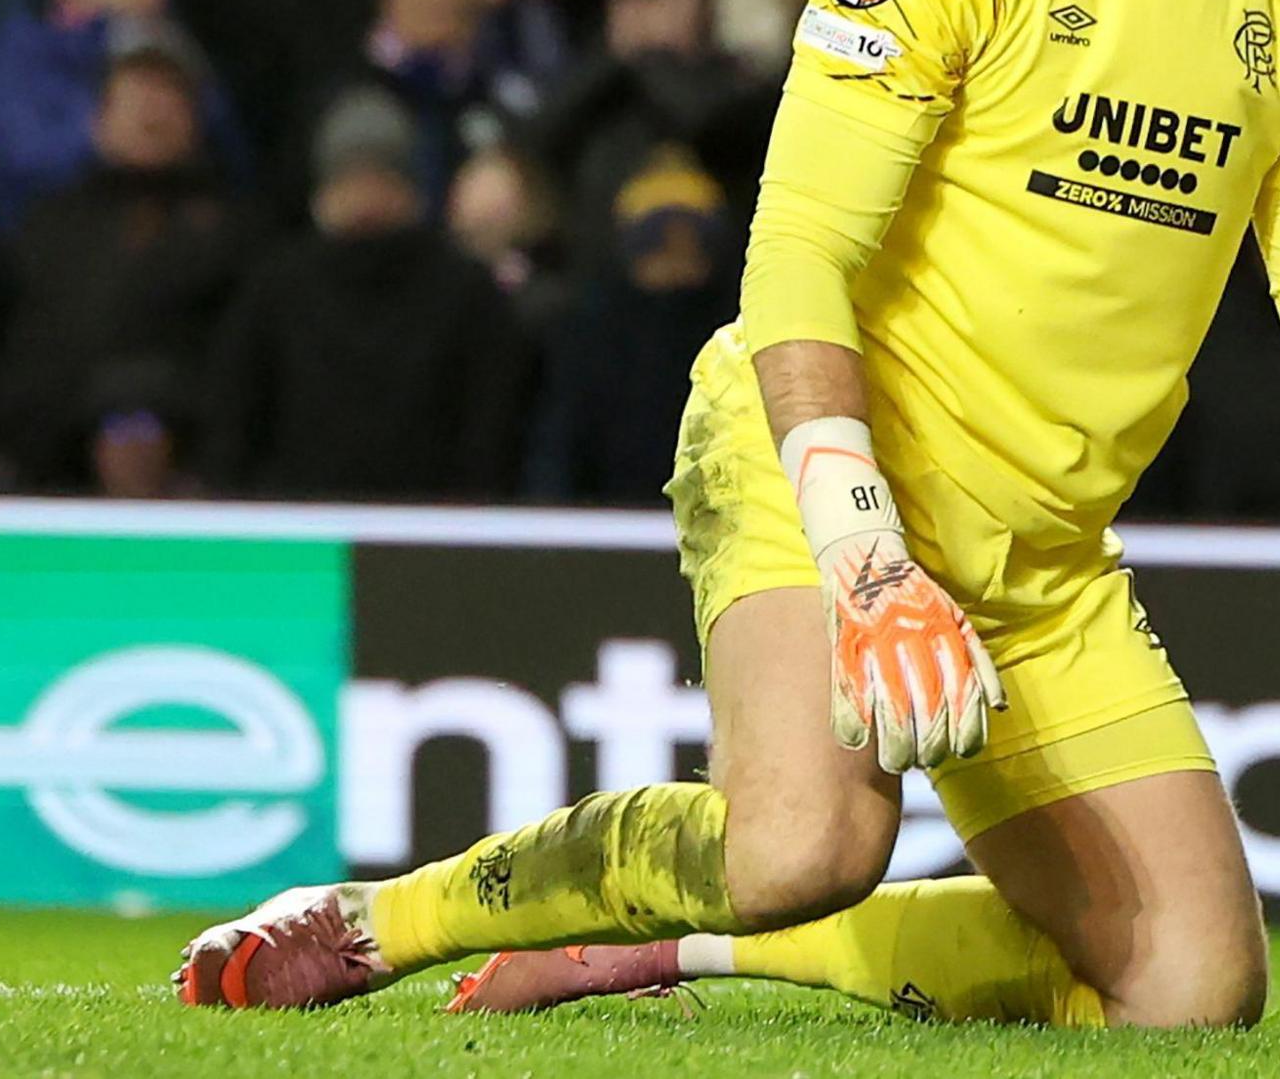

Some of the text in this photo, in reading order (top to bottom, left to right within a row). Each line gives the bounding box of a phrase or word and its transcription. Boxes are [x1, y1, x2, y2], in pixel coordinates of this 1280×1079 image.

[1050, 32, 1091, 47] umbro
[1051, 92, 1242, 168] UNIBET
[1055, 180, 1197, 228] ZERO% MISSION
